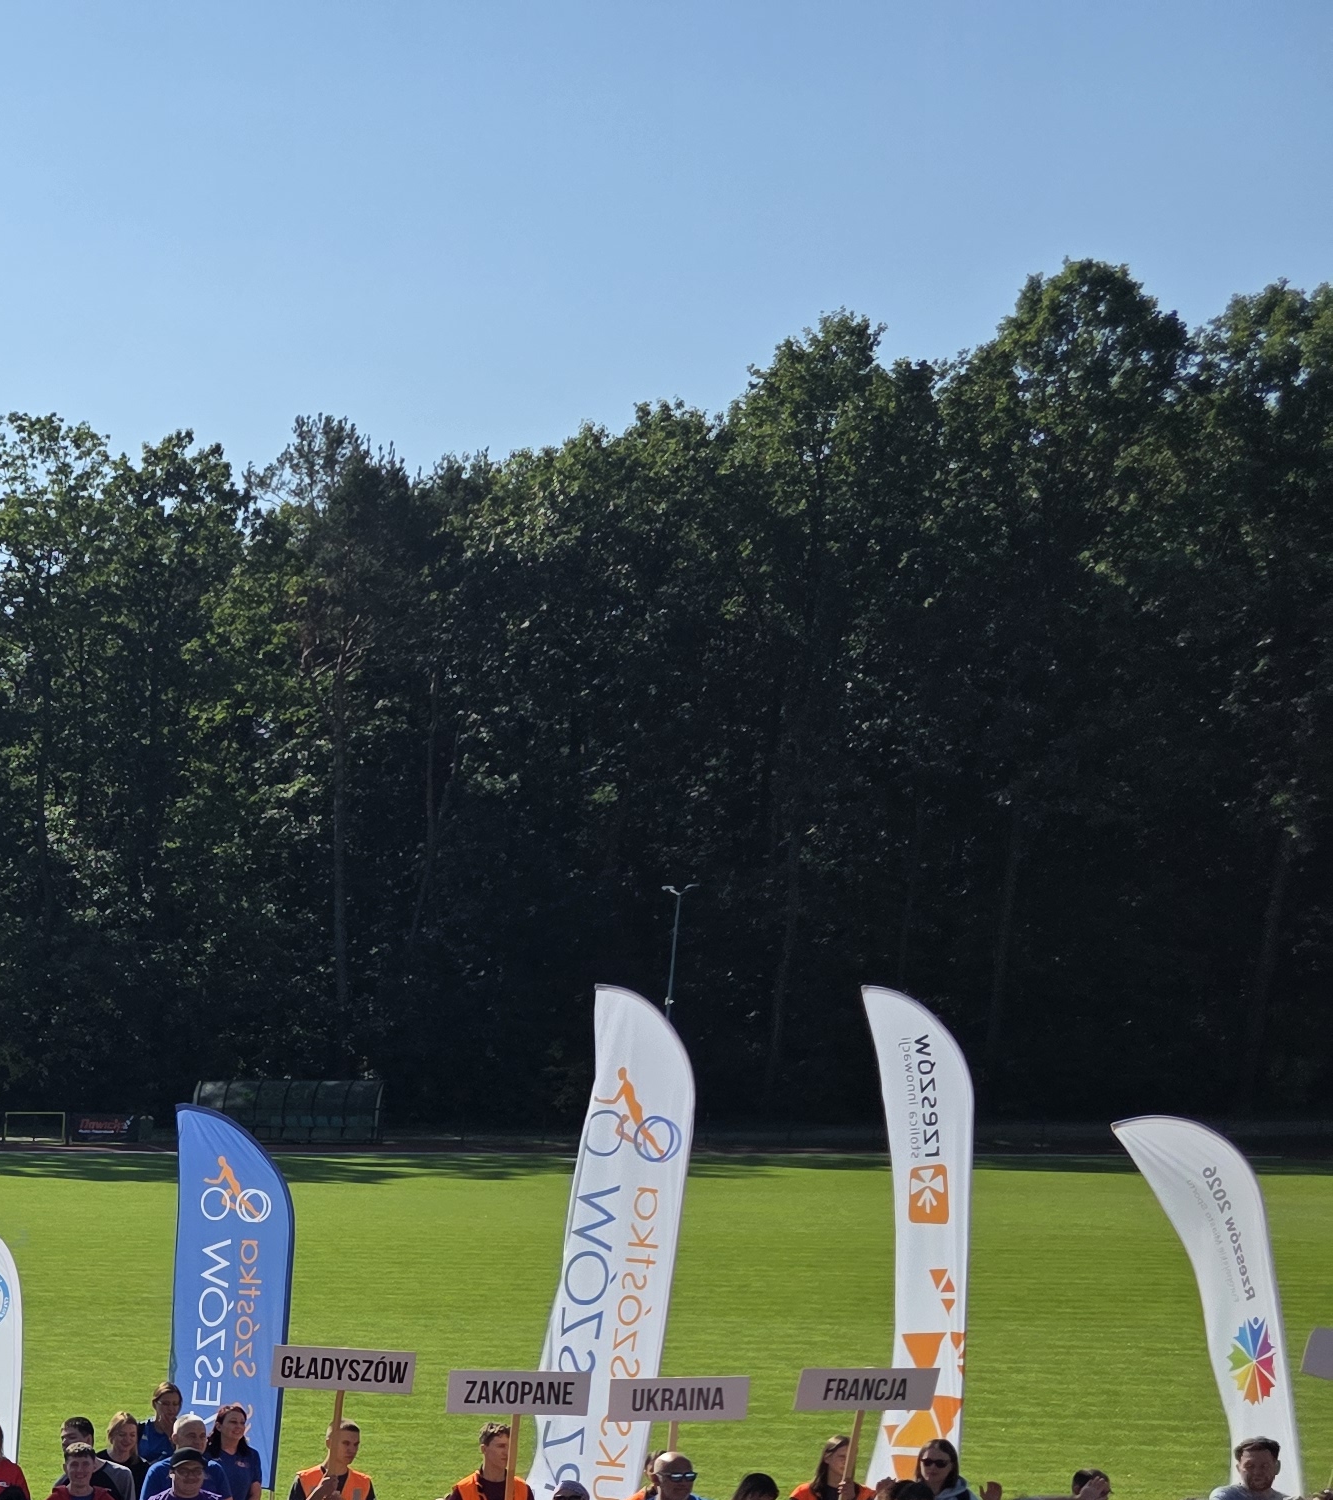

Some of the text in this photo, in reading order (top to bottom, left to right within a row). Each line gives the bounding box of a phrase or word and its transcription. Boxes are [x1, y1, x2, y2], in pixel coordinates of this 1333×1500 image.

[280, 1355, 408, 1385] GŁADYSZÓW
[464, 1380, 573, 1406] ZAKOPANE
[631, 1386, 724, 1412] UKRAINA
[823, 1378, 907, 1401] FRANCJA
